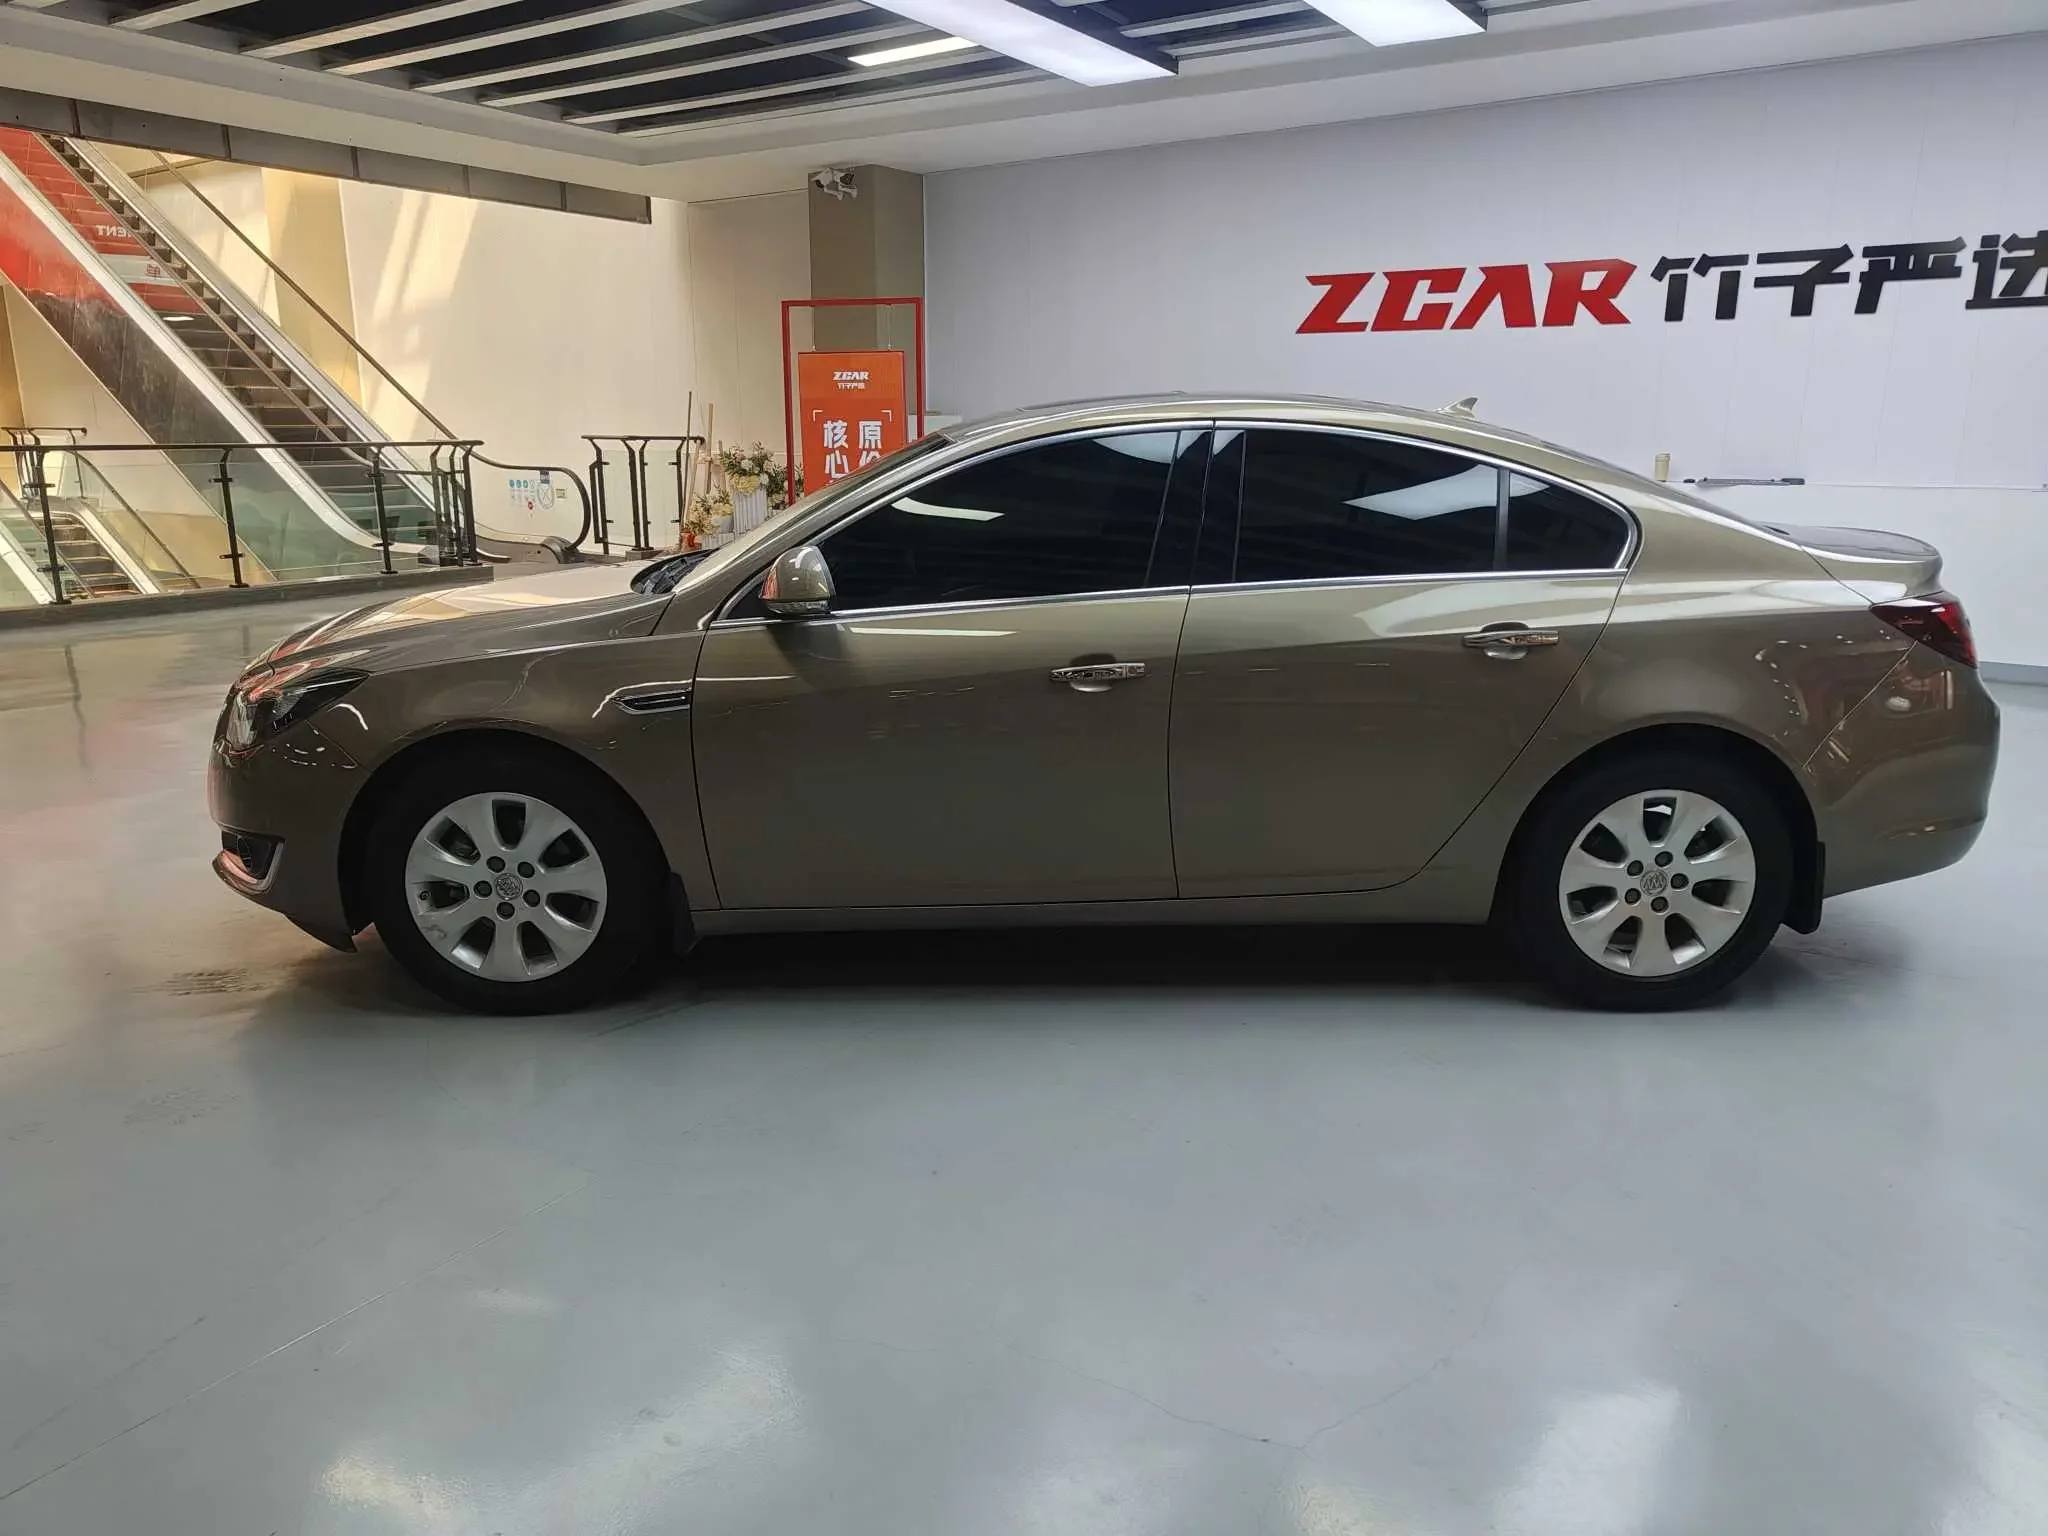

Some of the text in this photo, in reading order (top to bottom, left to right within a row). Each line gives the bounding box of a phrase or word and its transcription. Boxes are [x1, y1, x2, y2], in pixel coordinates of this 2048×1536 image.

[1295, 230, 2048, 334] ZCAR 竹子严选
[832, 371, 869, 381] ZCAR
[823, 419, 849, 483] 核心
